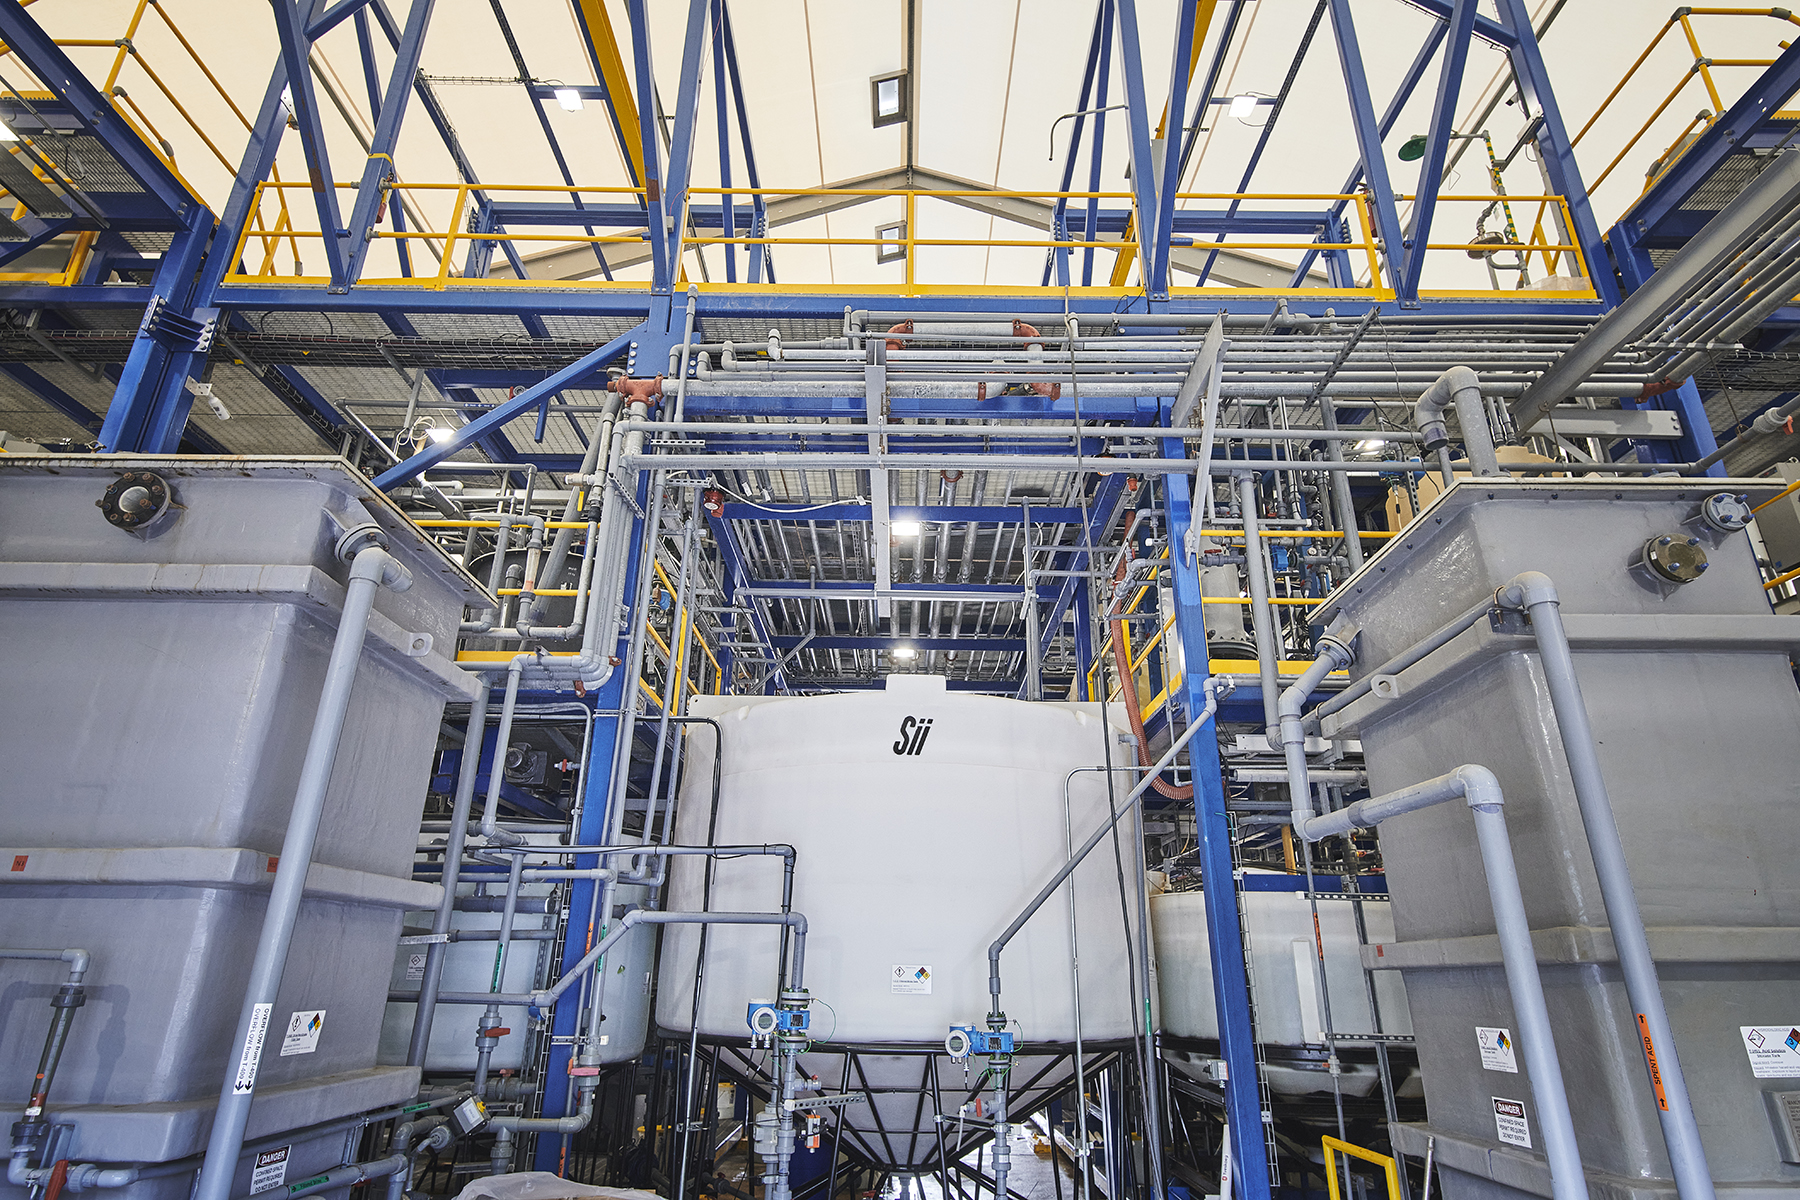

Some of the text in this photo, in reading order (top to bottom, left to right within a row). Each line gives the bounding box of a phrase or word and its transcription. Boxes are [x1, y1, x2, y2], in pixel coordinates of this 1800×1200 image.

[893, 715, 934, 756] Sii
[247, 1008, 261, 1046] OVERFLOW
[257, 1008, 270, 1045] OVERFLOW
[243, 1045, 252, 1061] from
[1644, 1036, 1661, 1086] SPENT ACID
[1498, 1103, 1521, 1115] DANGER
[261, 1150, 286, 1164] DANGER
